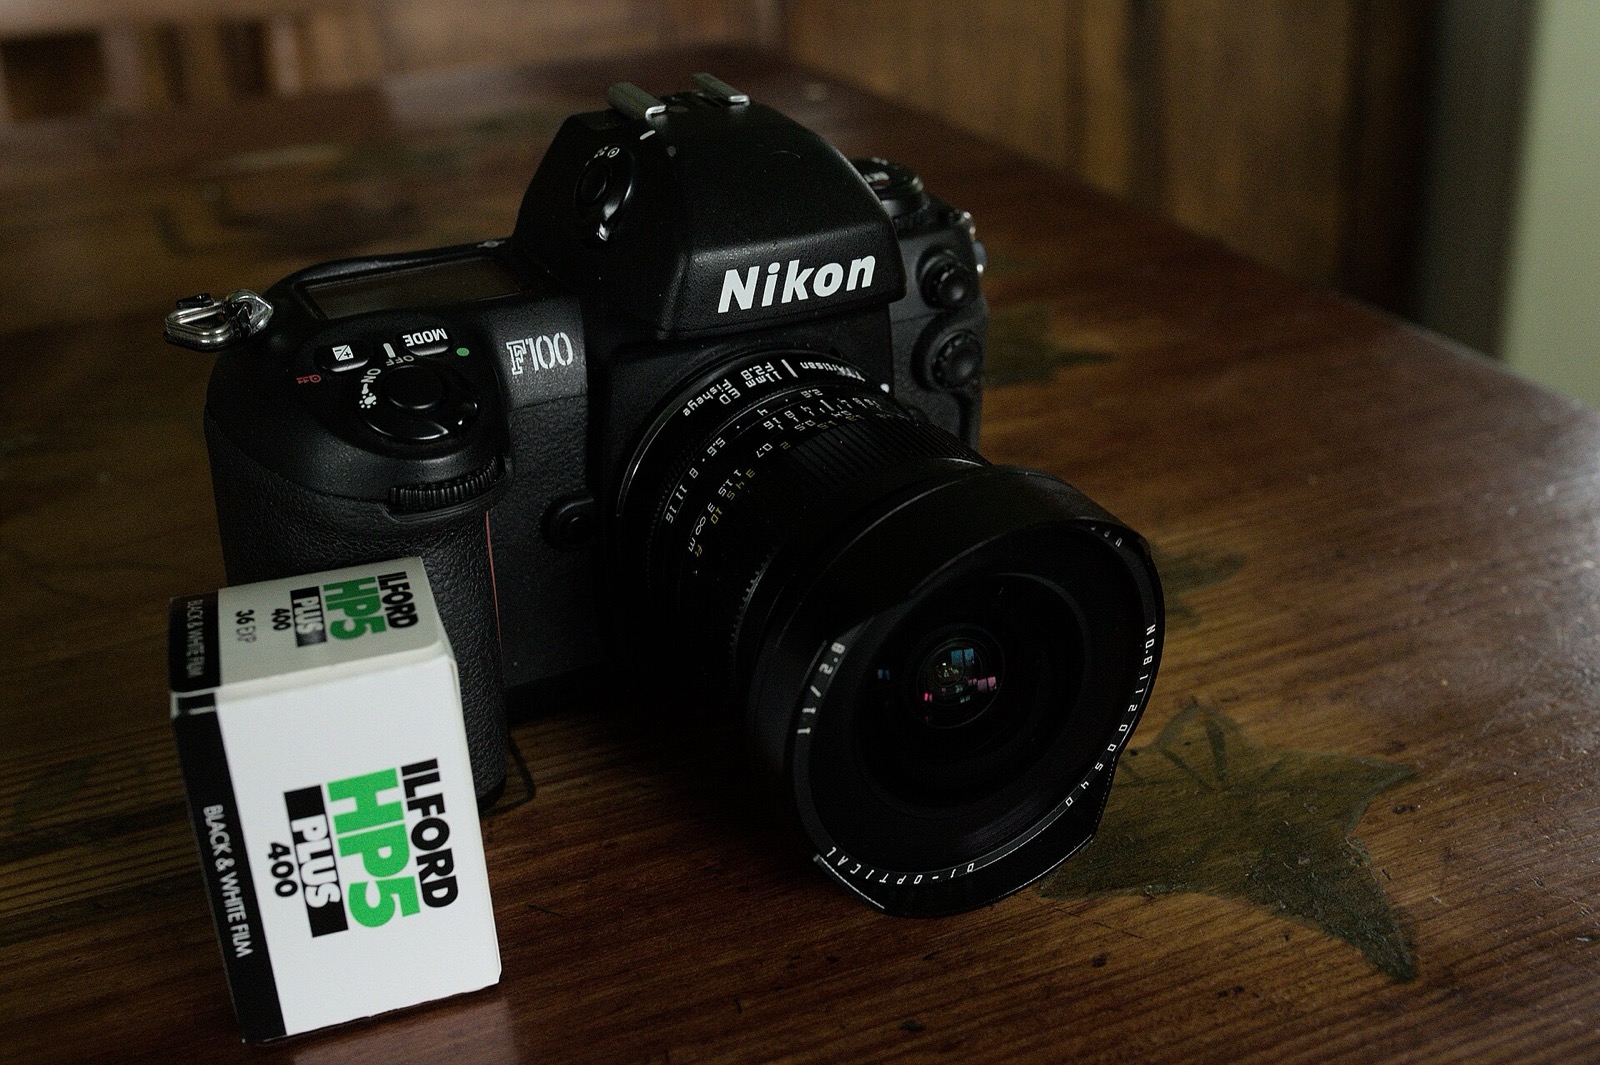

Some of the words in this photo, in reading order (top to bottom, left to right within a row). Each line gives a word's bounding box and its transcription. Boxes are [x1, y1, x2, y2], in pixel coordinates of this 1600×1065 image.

[717, 254, 877, 314] Nikon
[402, 328, 448, 348] MODE
[386, 354, 414, 367] OFF
[506, 332, 574, 376] F100
[361, 368, 382, 384] ON
[740, 361, 776, 380] F2.8
[745, 371, 783, 389] 11mm
[682, 378, 732, 417] Fisheye
[718, 384, 742, 406] ED
[800, 388, 823, 399] 2.8
[706, 437, 726, 457] 5.6
[756, 442, 773, 458] 0.7
[688, 467, 699, 479] 8
[675, 484, 688, 501] 11
[665, 505, 677, 524] 16
[323, 576, 387, 640] HP5
[377, 571, 418, 628] ILFORD
[235, 609, 254, 625] 36
[271, 608, 291, 631] 400
[292, 597, 323, 636] PLUS
[236, 625, 257, 643] EXP
[797, 641, 846, 735] 11/2.8
[203, 804, 232, 857] BLACK
[401, 758, 459, 908] ILFORD
[327, 768, 420, 928] HP5
[215, 857, 236, 873] &
[268, 842, 298, 897] 400
[290, 813, 342, 908] PLUS
[219, 871, 249, 924] WHITE
[230, 923, 254, 958] FILM
